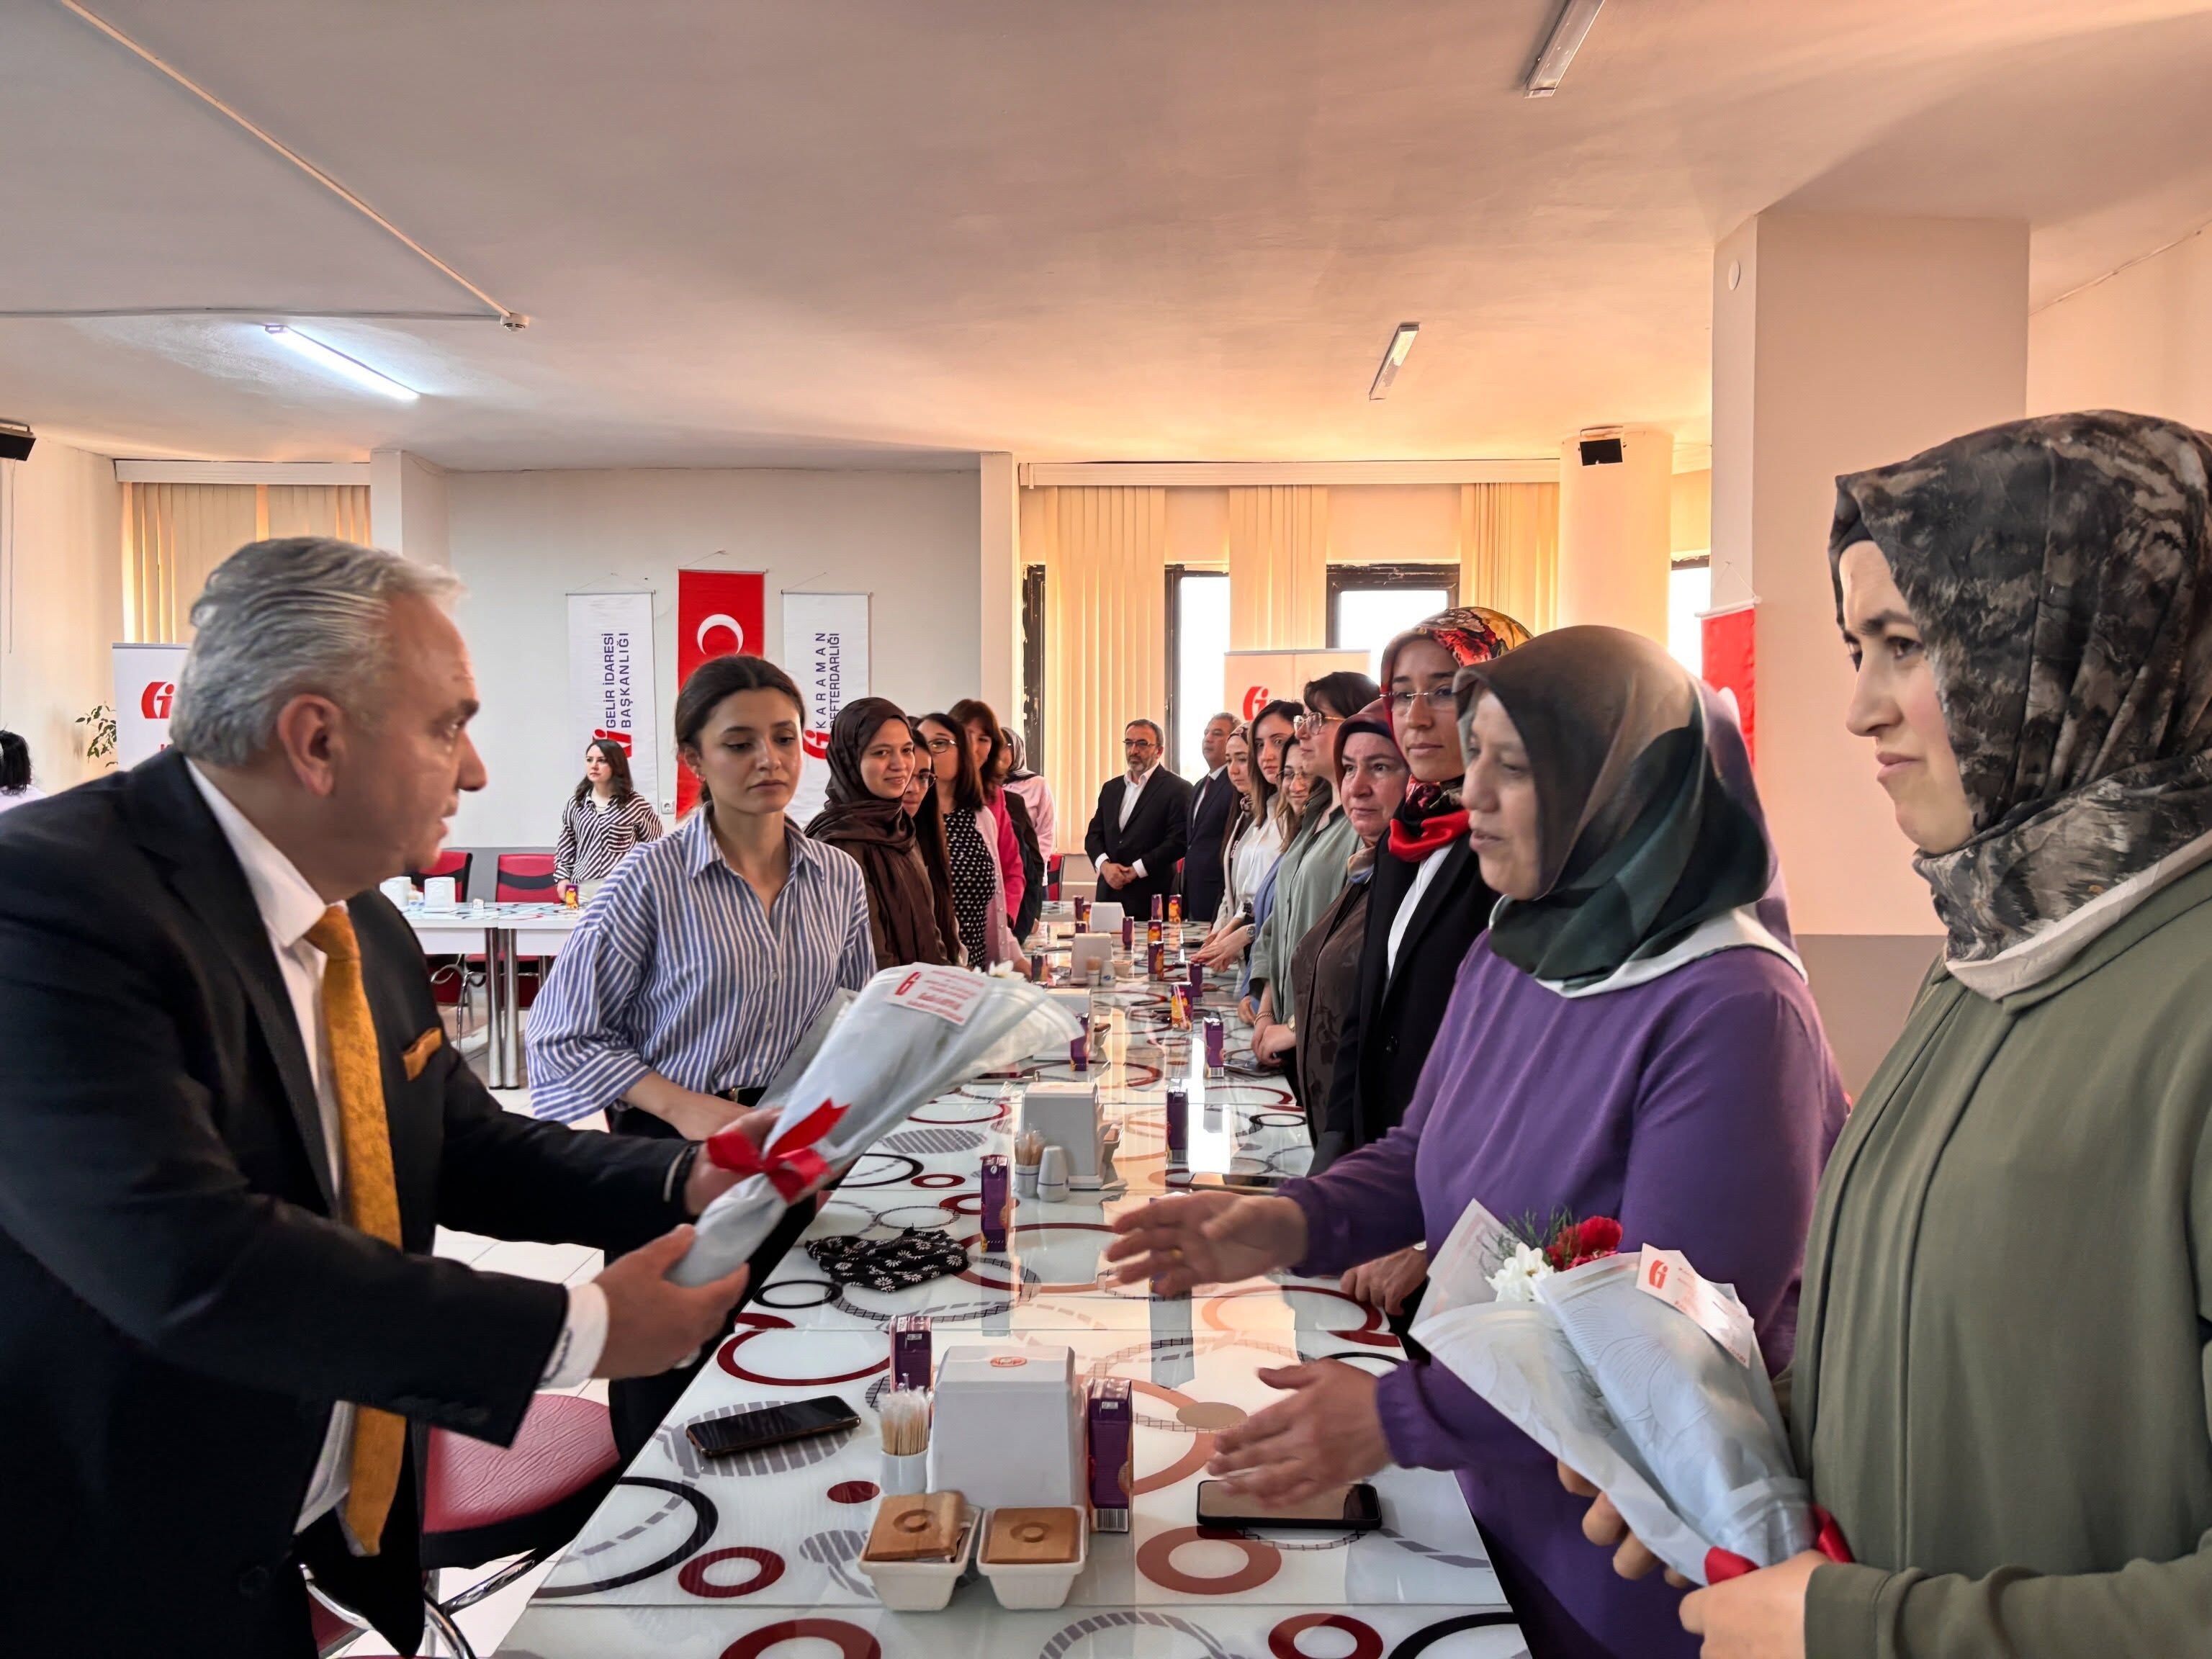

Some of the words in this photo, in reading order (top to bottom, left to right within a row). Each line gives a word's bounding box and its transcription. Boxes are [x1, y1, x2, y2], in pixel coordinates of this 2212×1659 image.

[601, 633, 614, 685] İDARESİ
[617, 633, 633, 728] BAŞKANLIĞI
[815, 633, 827, 729] KARAMAN
[603, 690, 616, 728] GELİR
